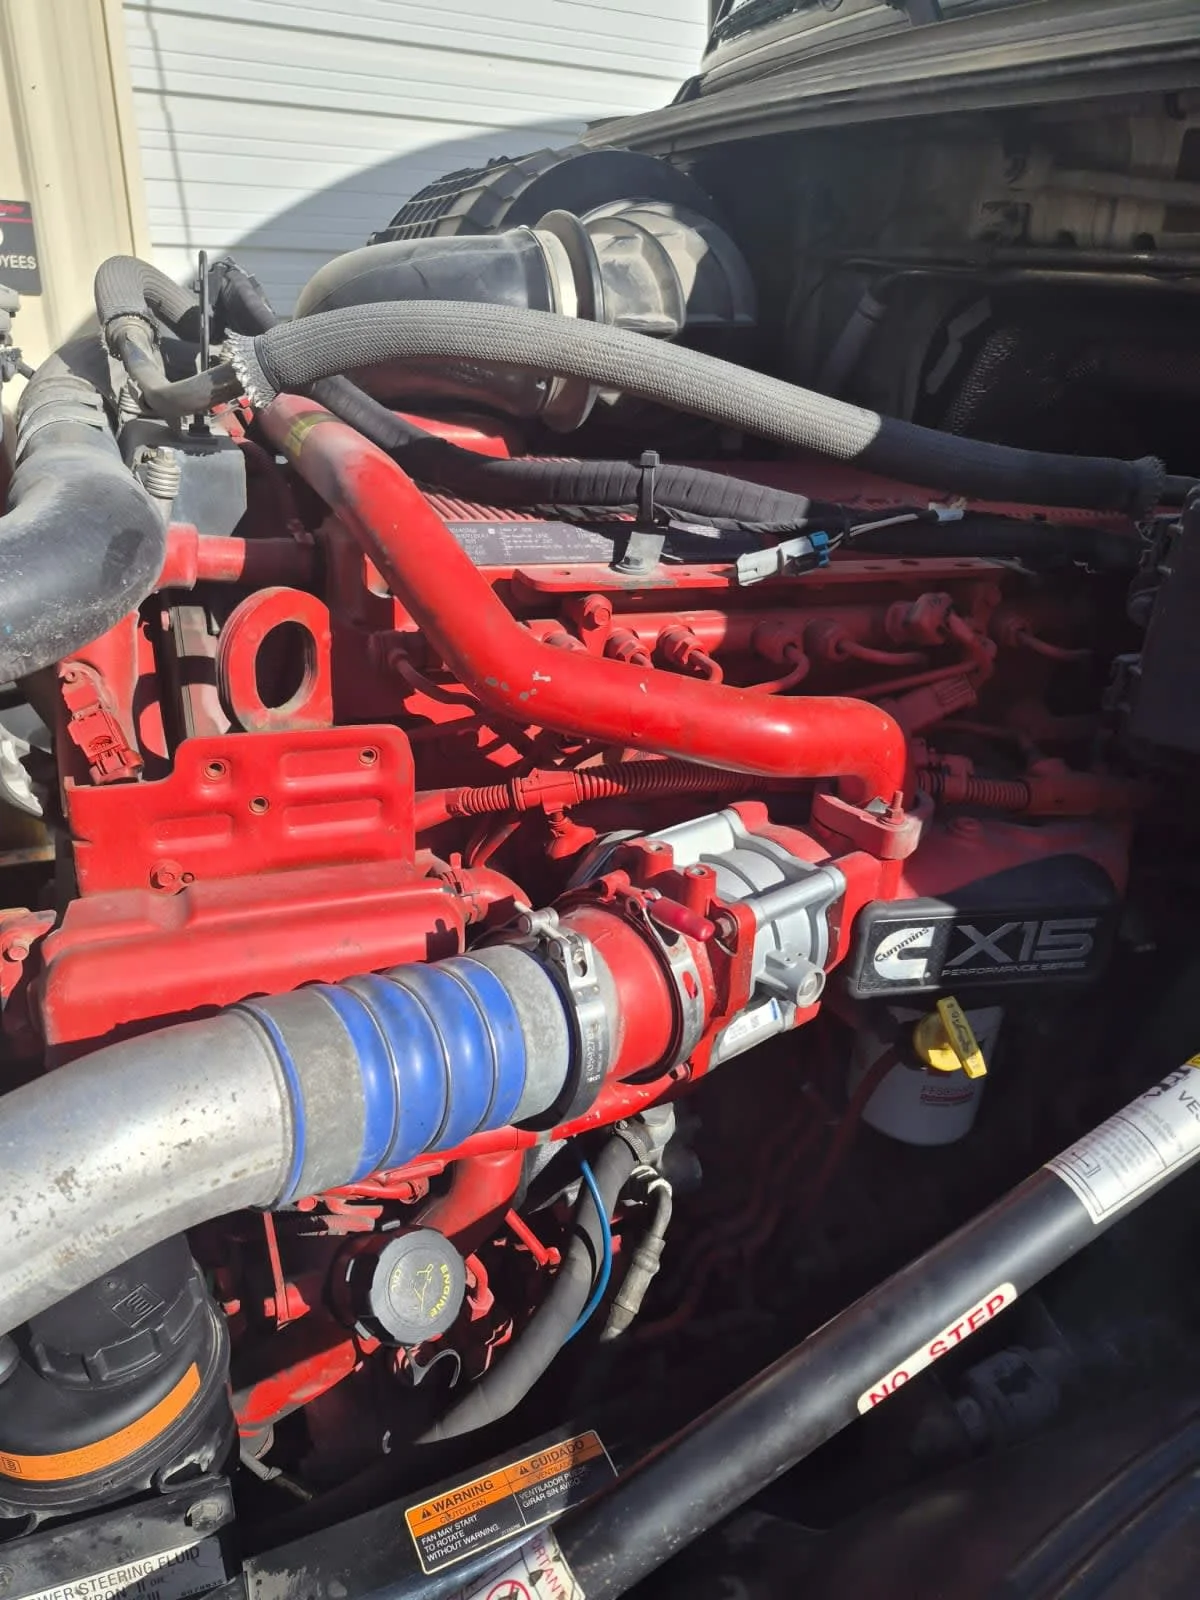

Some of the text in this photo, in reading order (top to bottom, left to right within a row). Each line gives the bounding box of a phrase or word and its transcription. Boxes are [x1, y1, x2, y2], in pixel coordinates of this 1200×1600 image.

[875, 928, 930, 962] Cummins
[945, 918, 1098, 967] X15
[941, 963, 1040, 977] PERFORMANCE
[427, 1263, 452, 1318] ENGINE
[869, 1294, 1005, 1407] NO STEP
[530, 1440, 584, 1470] CUIDADO
[432, 1480, 494, 1513] WARNING
[519, 1474, 564, 1500] VENTILADOR
[522, 1493, 547, 1508] GIRAR
[545, 1488, 560, 1498] SIN
[472, 1498, 488, 1511] FAN
[421, 1514, 478, 1545] FAN MAY START
[424, 1529, 465, 1553] TO ROTATE
[426, 1541, 462, 1562] WITHOUT
[78, 1561, 155, 1596] STEERING
[158, 1545, 200, 1569] FLUID
